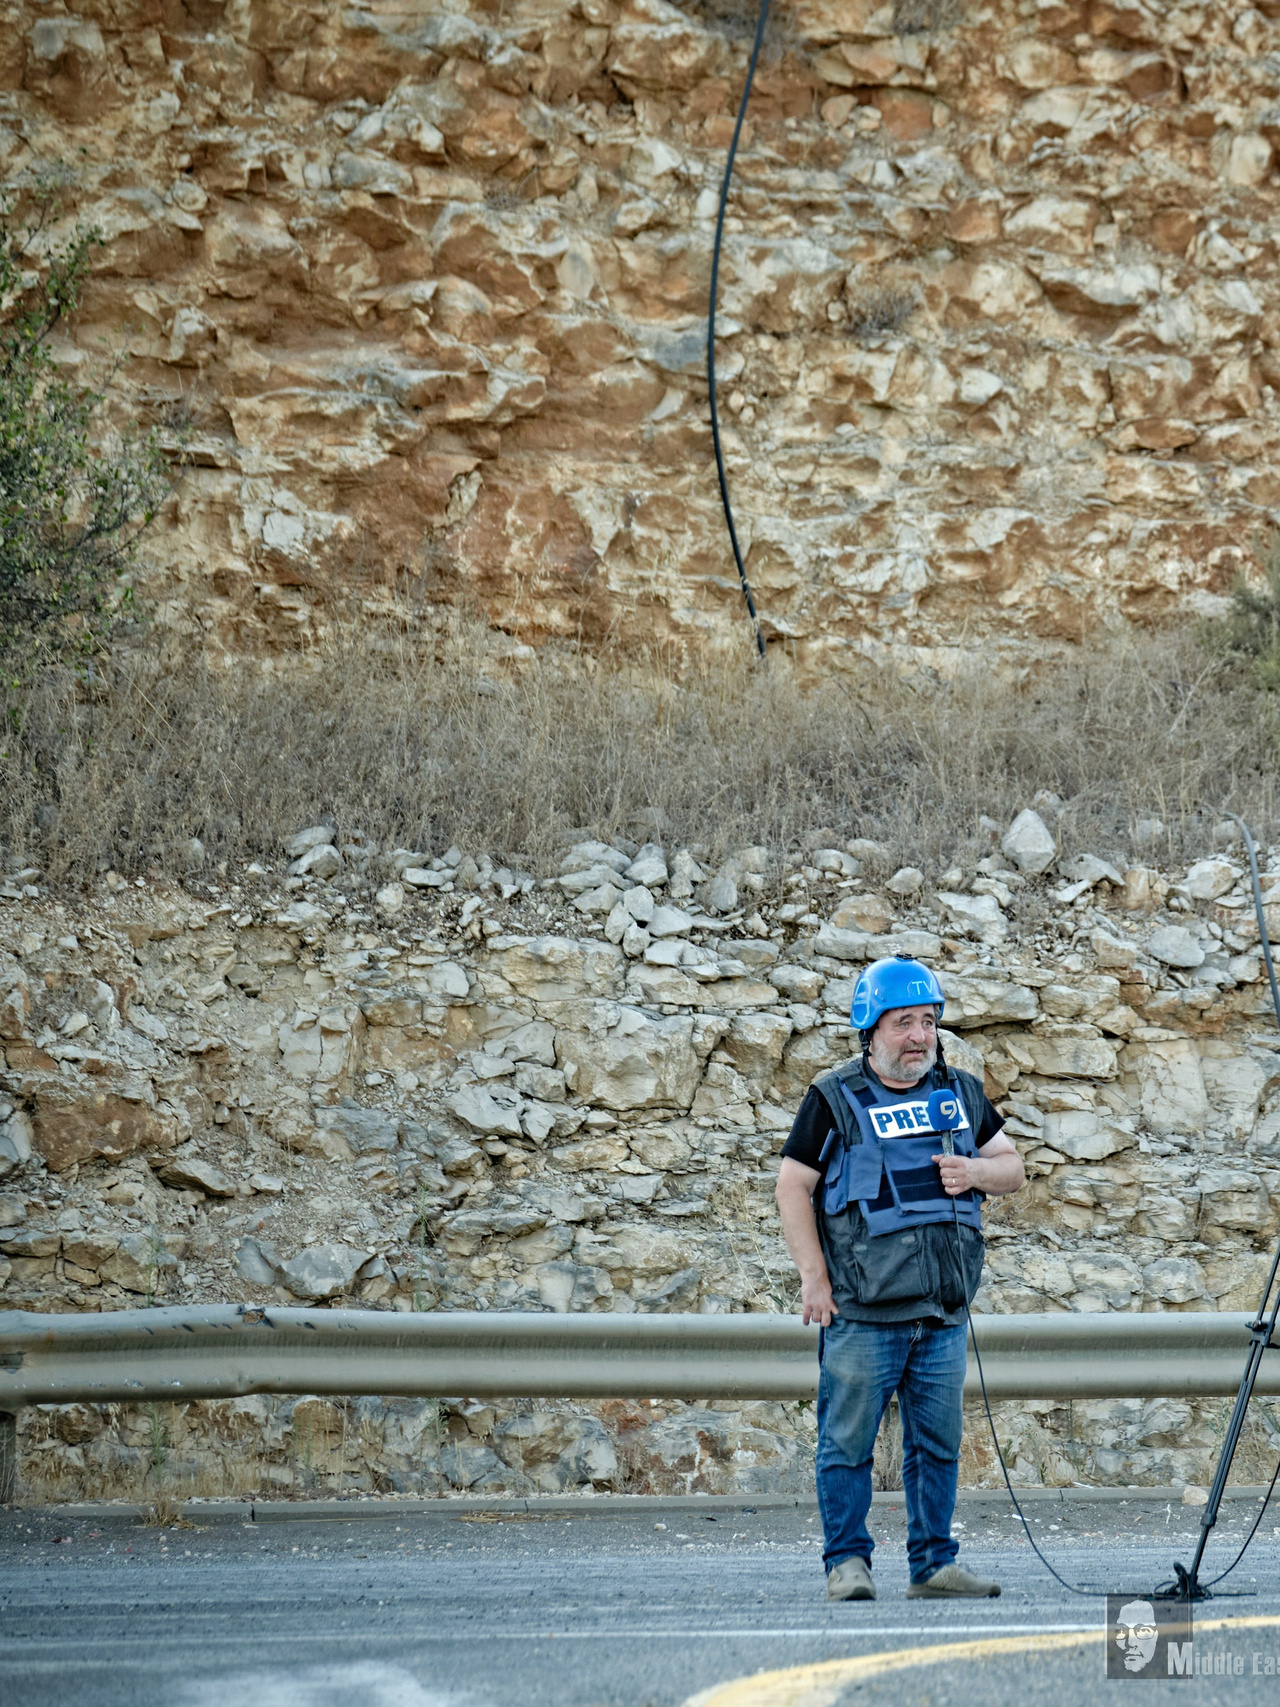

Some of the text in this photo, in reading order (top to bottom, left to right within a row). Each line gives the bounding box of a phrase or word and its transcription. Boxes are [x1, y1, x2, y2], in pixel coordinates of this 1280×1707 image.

[912, 980, 933, 995] TV
[940, 1101, 957, 1119] 9
[875, 1106, 963, 1133] PRE
